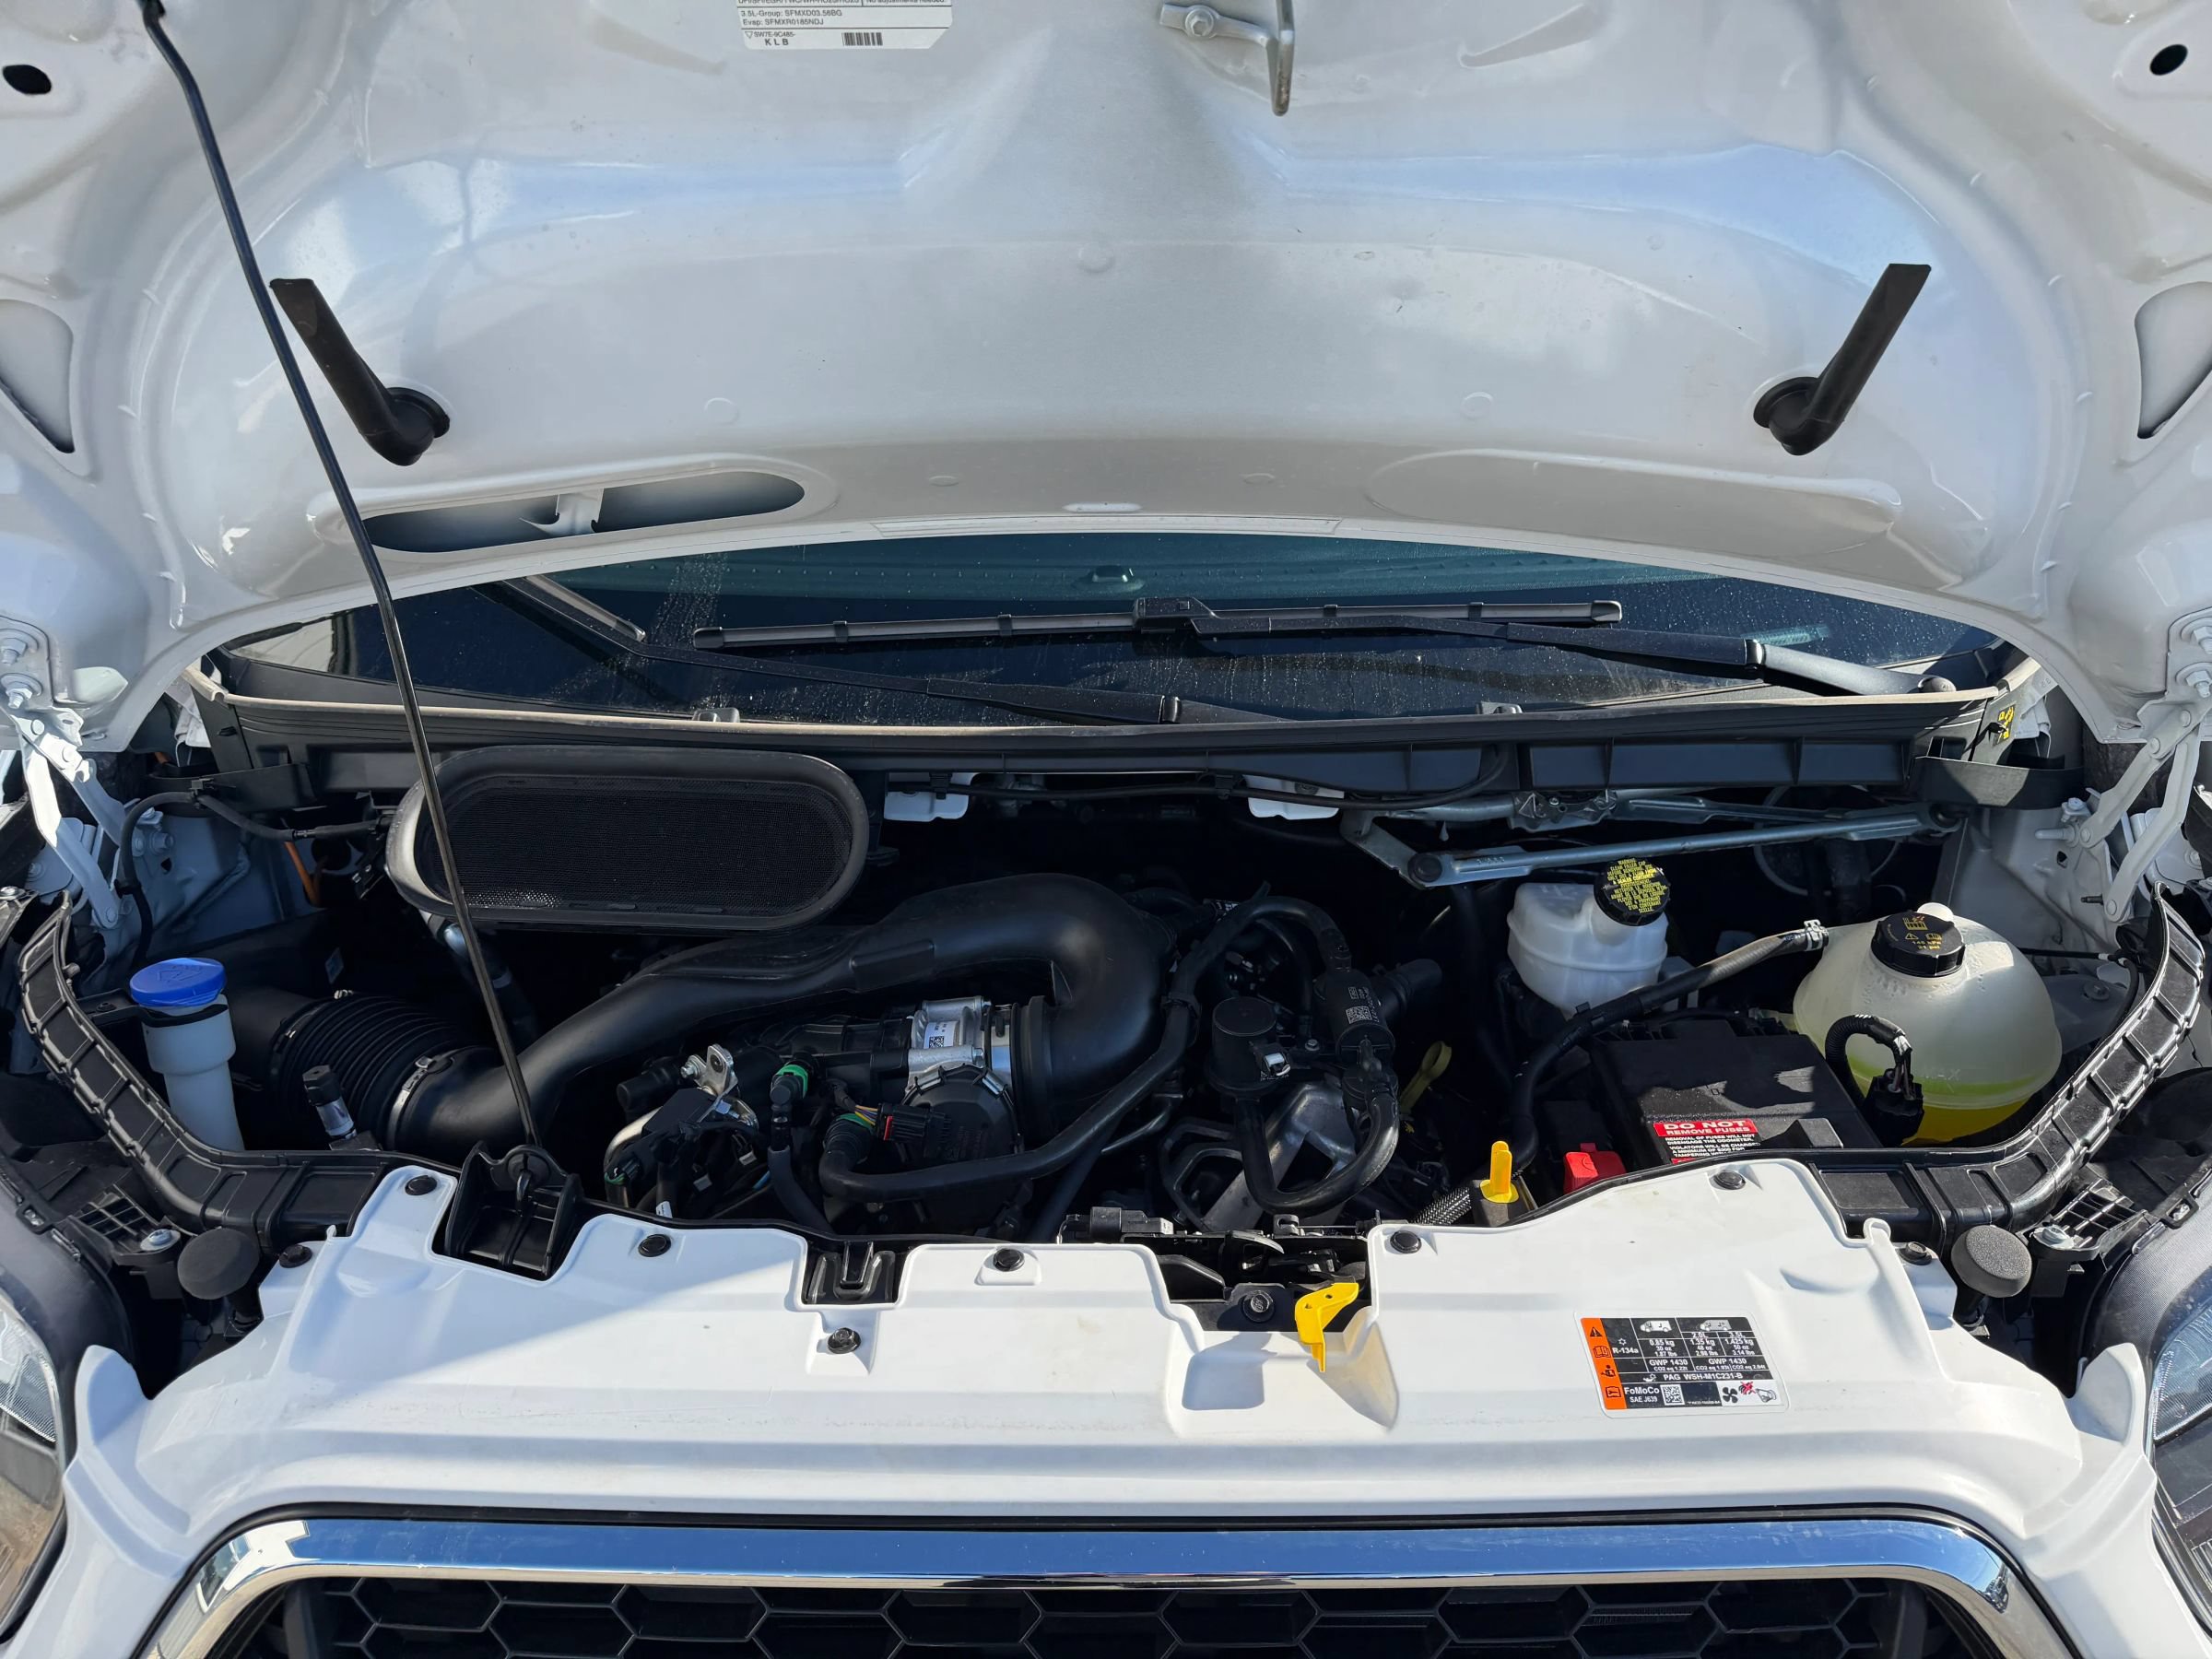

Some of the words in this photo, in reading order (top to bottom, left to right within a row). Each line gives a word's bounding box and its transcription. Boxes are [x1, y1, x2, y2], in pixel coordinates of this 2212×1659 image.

[1701, 1120, 1746, 1128] NOT
[1683, 1372, 1743, 1381] WSH-M1C231-B
[1623, 1386, 1660, 1394] FoMoCo
